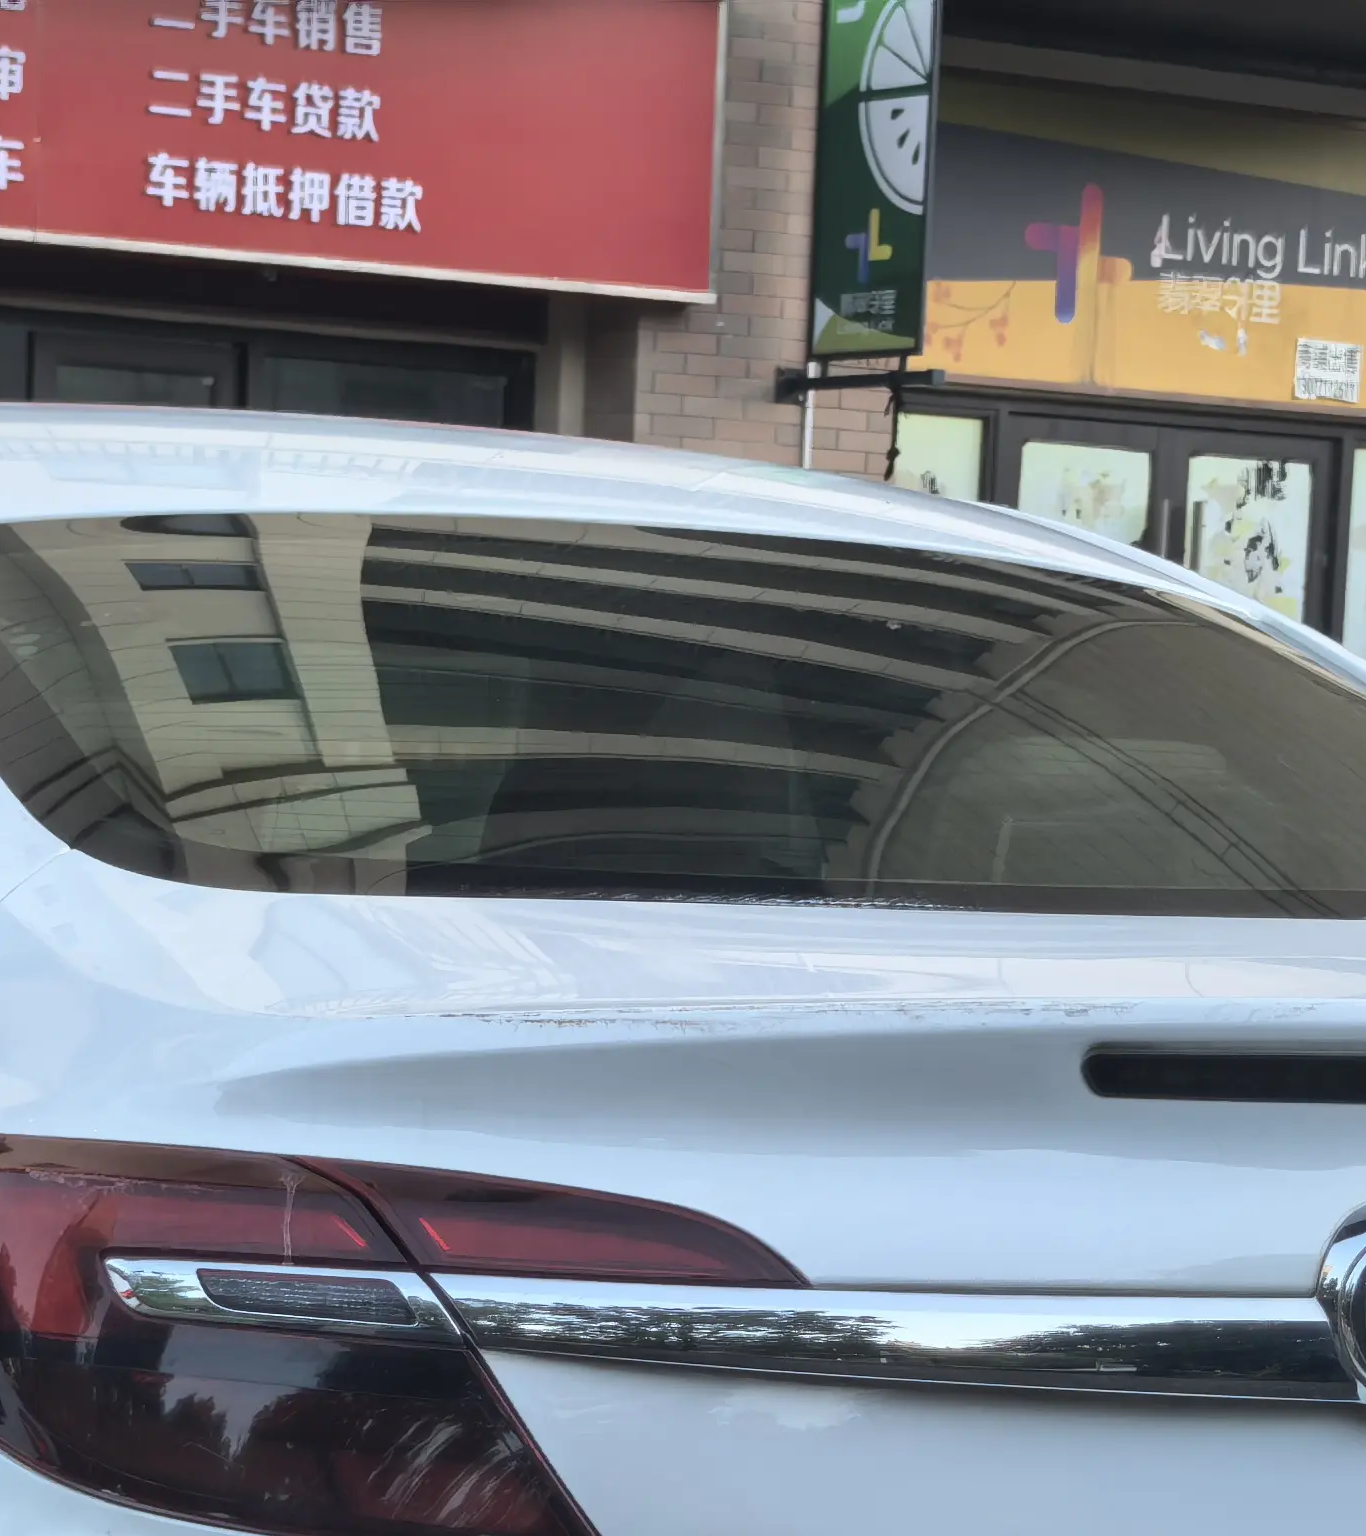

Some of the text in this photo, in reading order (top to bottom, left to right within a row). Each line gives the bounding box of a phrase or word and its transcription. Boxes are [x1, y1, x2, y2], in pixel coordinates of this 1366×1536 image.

[148, 70, 382, 142] 二手车贷款
[145, 152, 424, 233] 车辆抵押借款
[1156, 212, 1285, 280] Living
